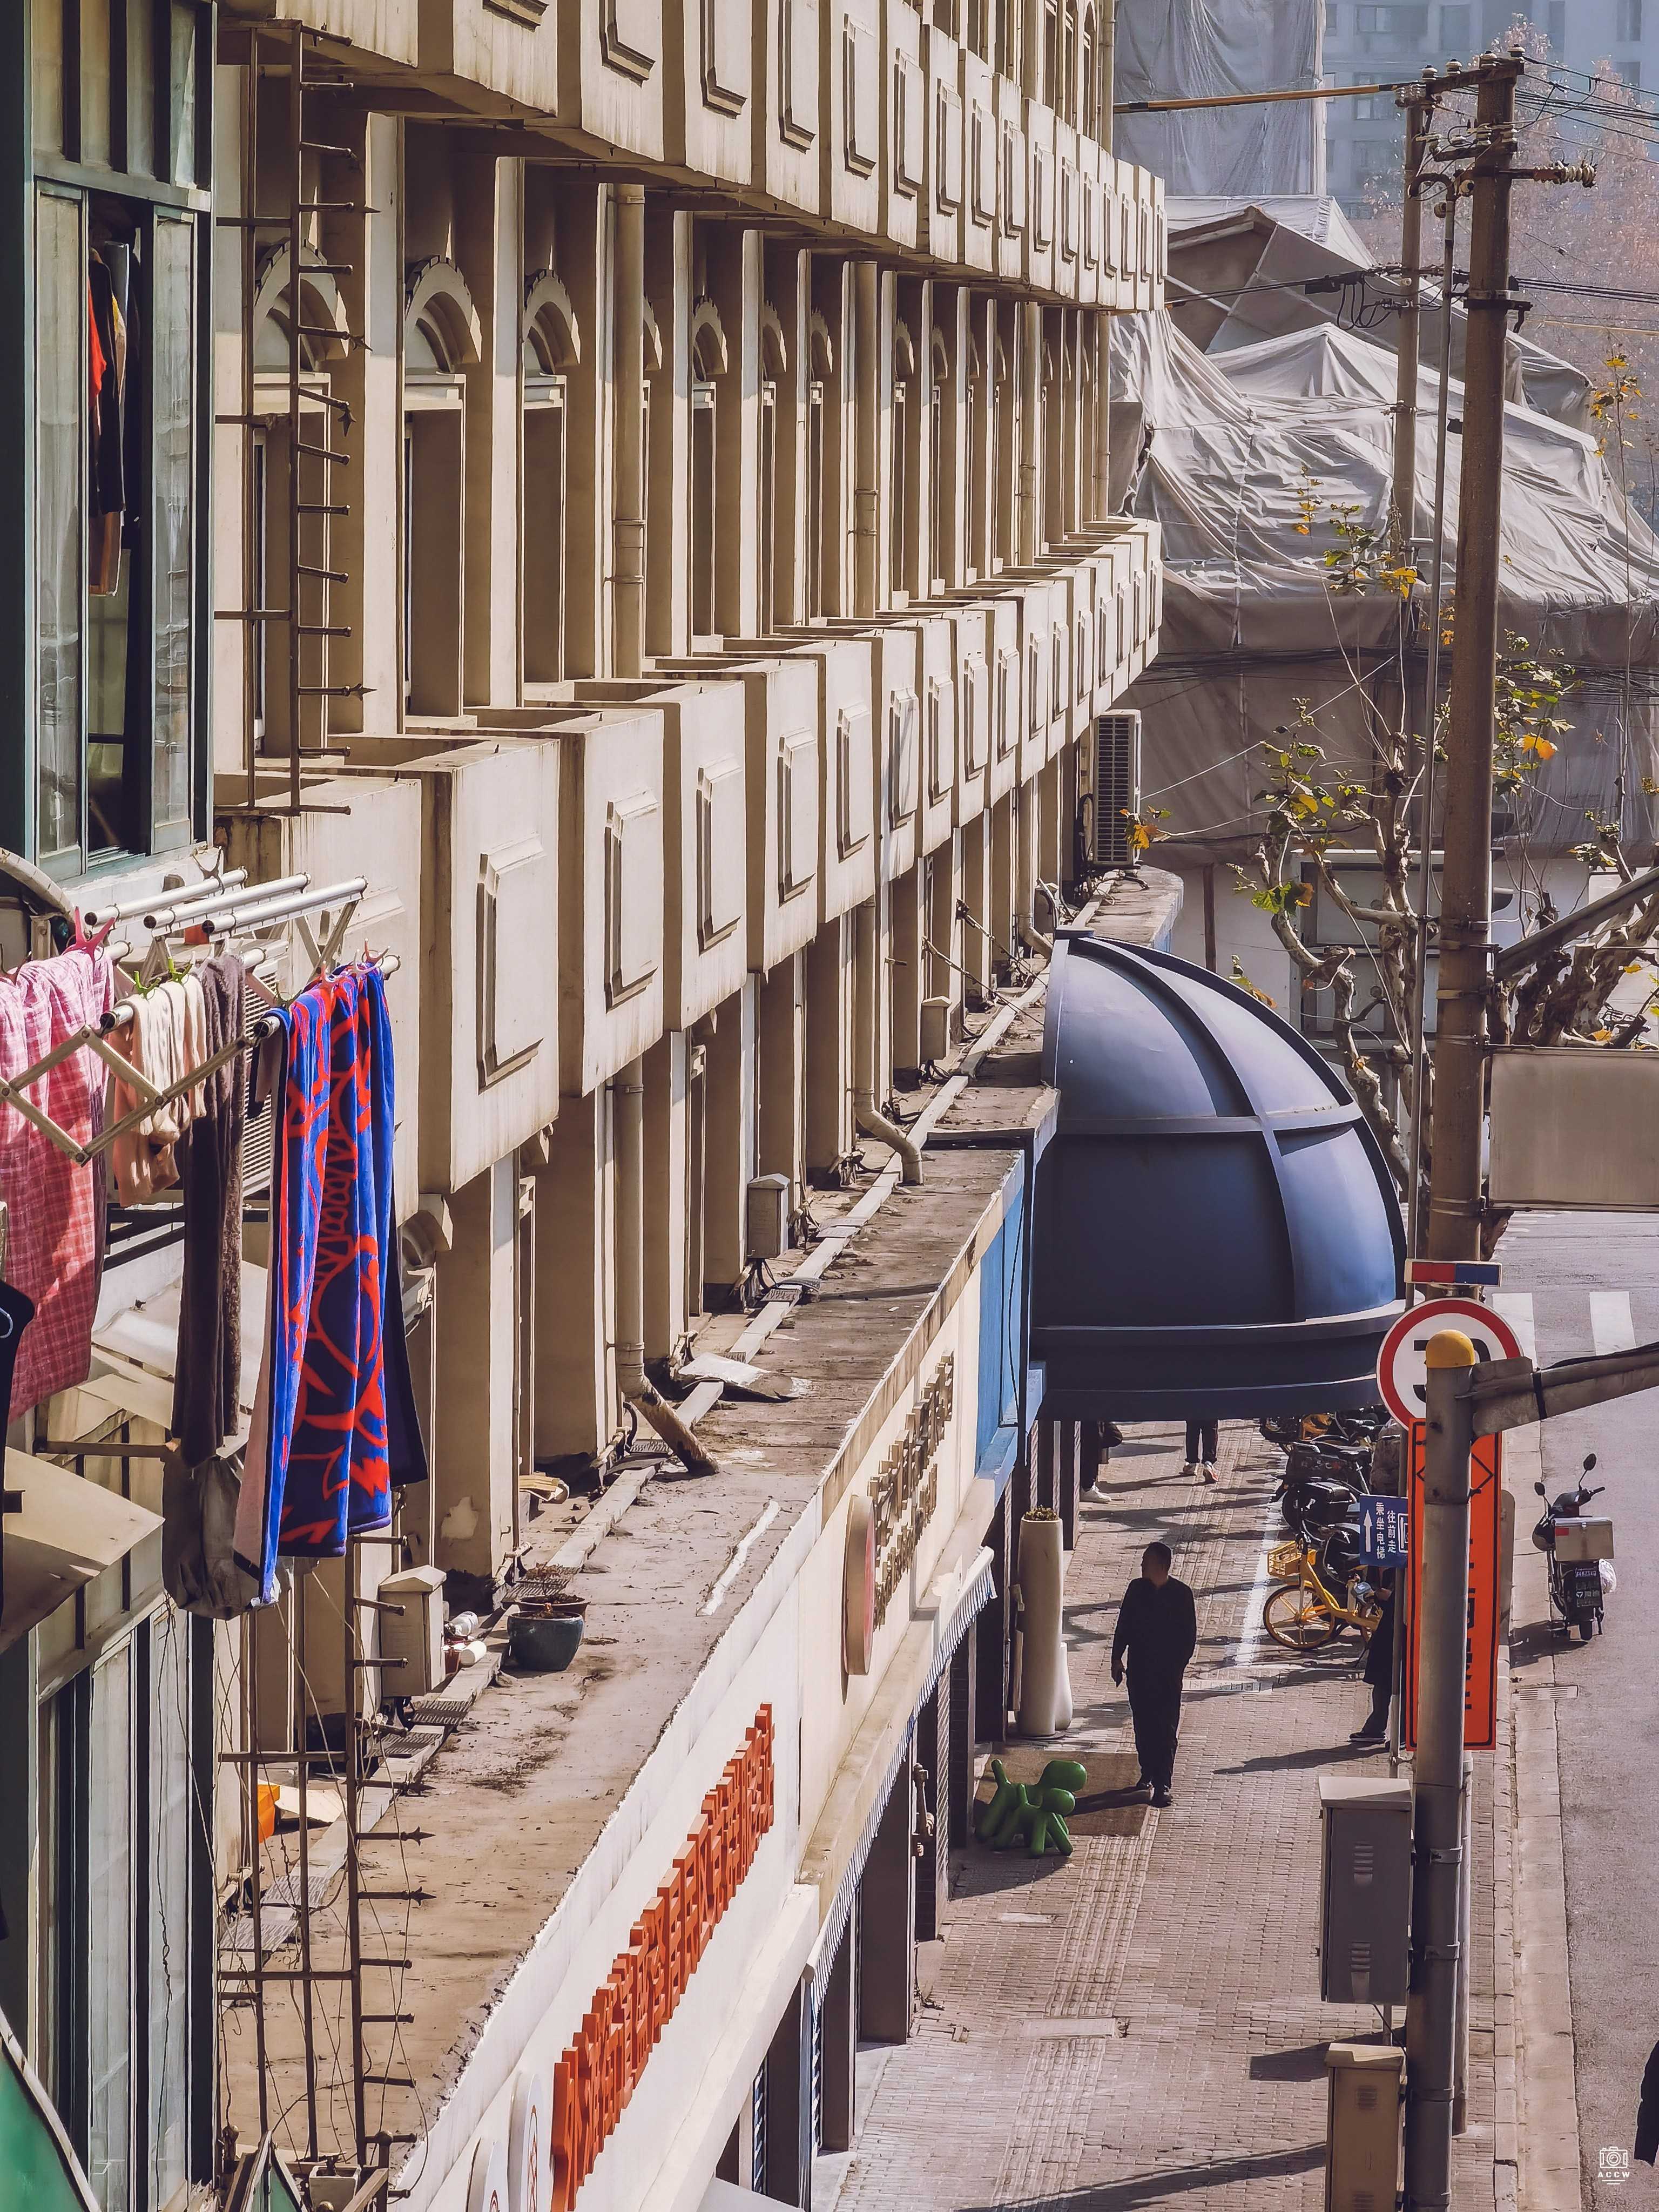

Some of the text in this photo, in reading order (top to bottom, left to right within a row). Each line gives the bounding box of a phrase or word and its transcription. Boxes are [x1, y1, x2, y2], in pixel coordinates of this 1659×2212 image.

[1375, 1501, 1386, 1560] 乘坐电梯
[1387, 1510, 1397, 1554] 往前走
